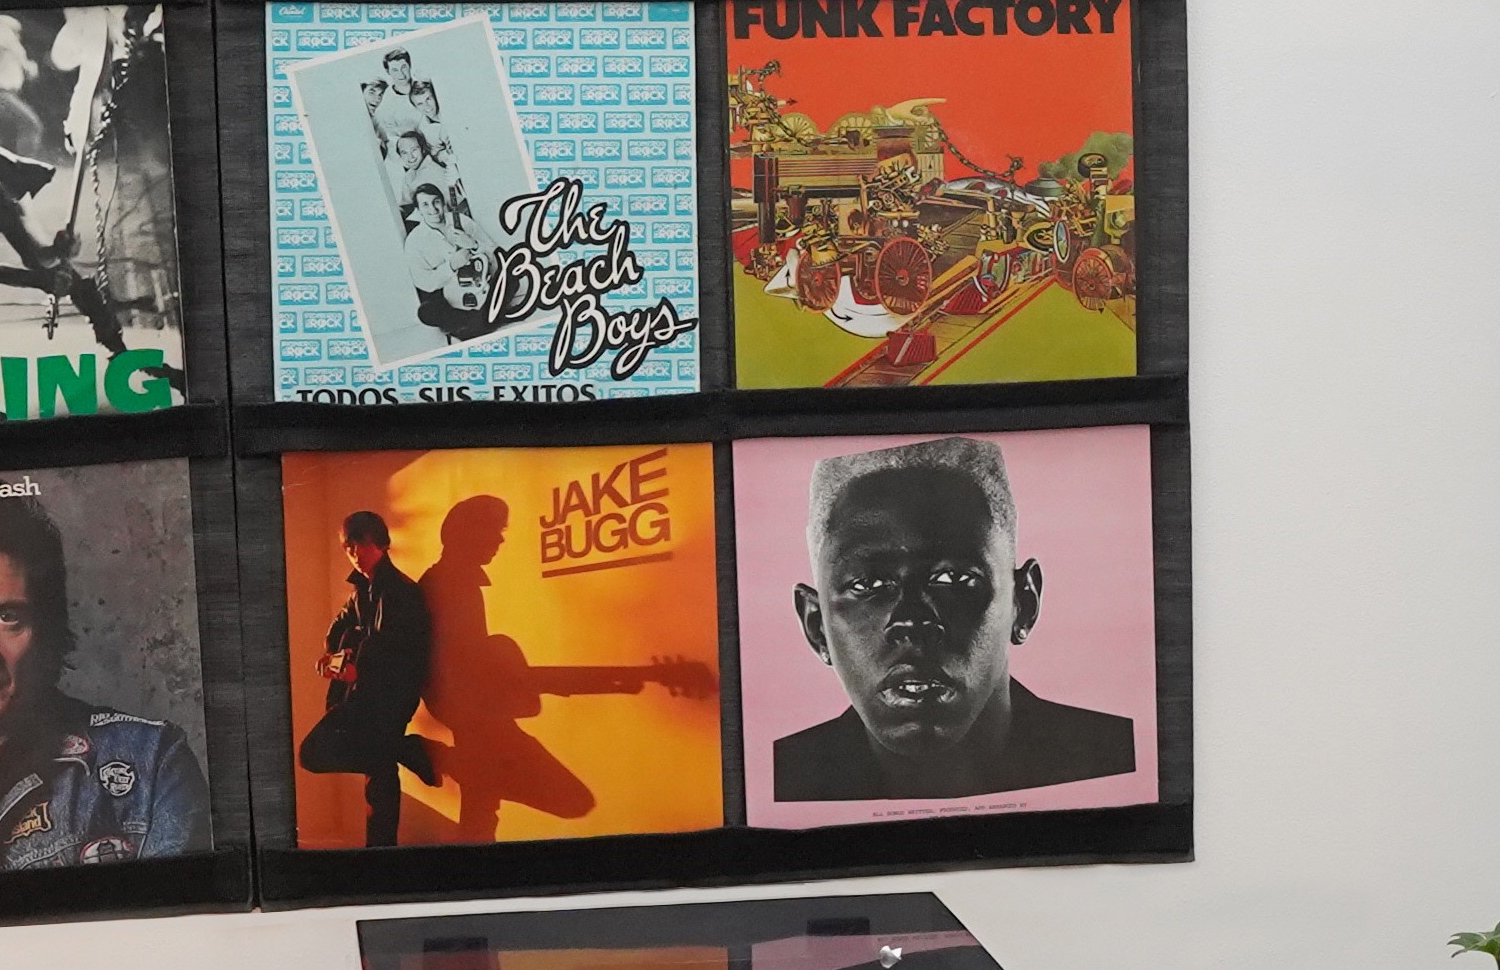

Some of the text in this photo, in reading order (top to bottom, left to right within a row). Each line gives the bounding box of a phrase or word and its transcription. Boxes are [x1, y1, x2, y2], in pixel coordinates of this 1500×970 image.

[502, 179, 620, 254] The
[487, 223, 642, 323] Beach
[552, 300, 694, 376] Boys
[296, 384, 596, 405] TODOS SUS EXITOS
[539, 447, 670, 529] JAKE
[541, 502, 671, 564] BUGG
